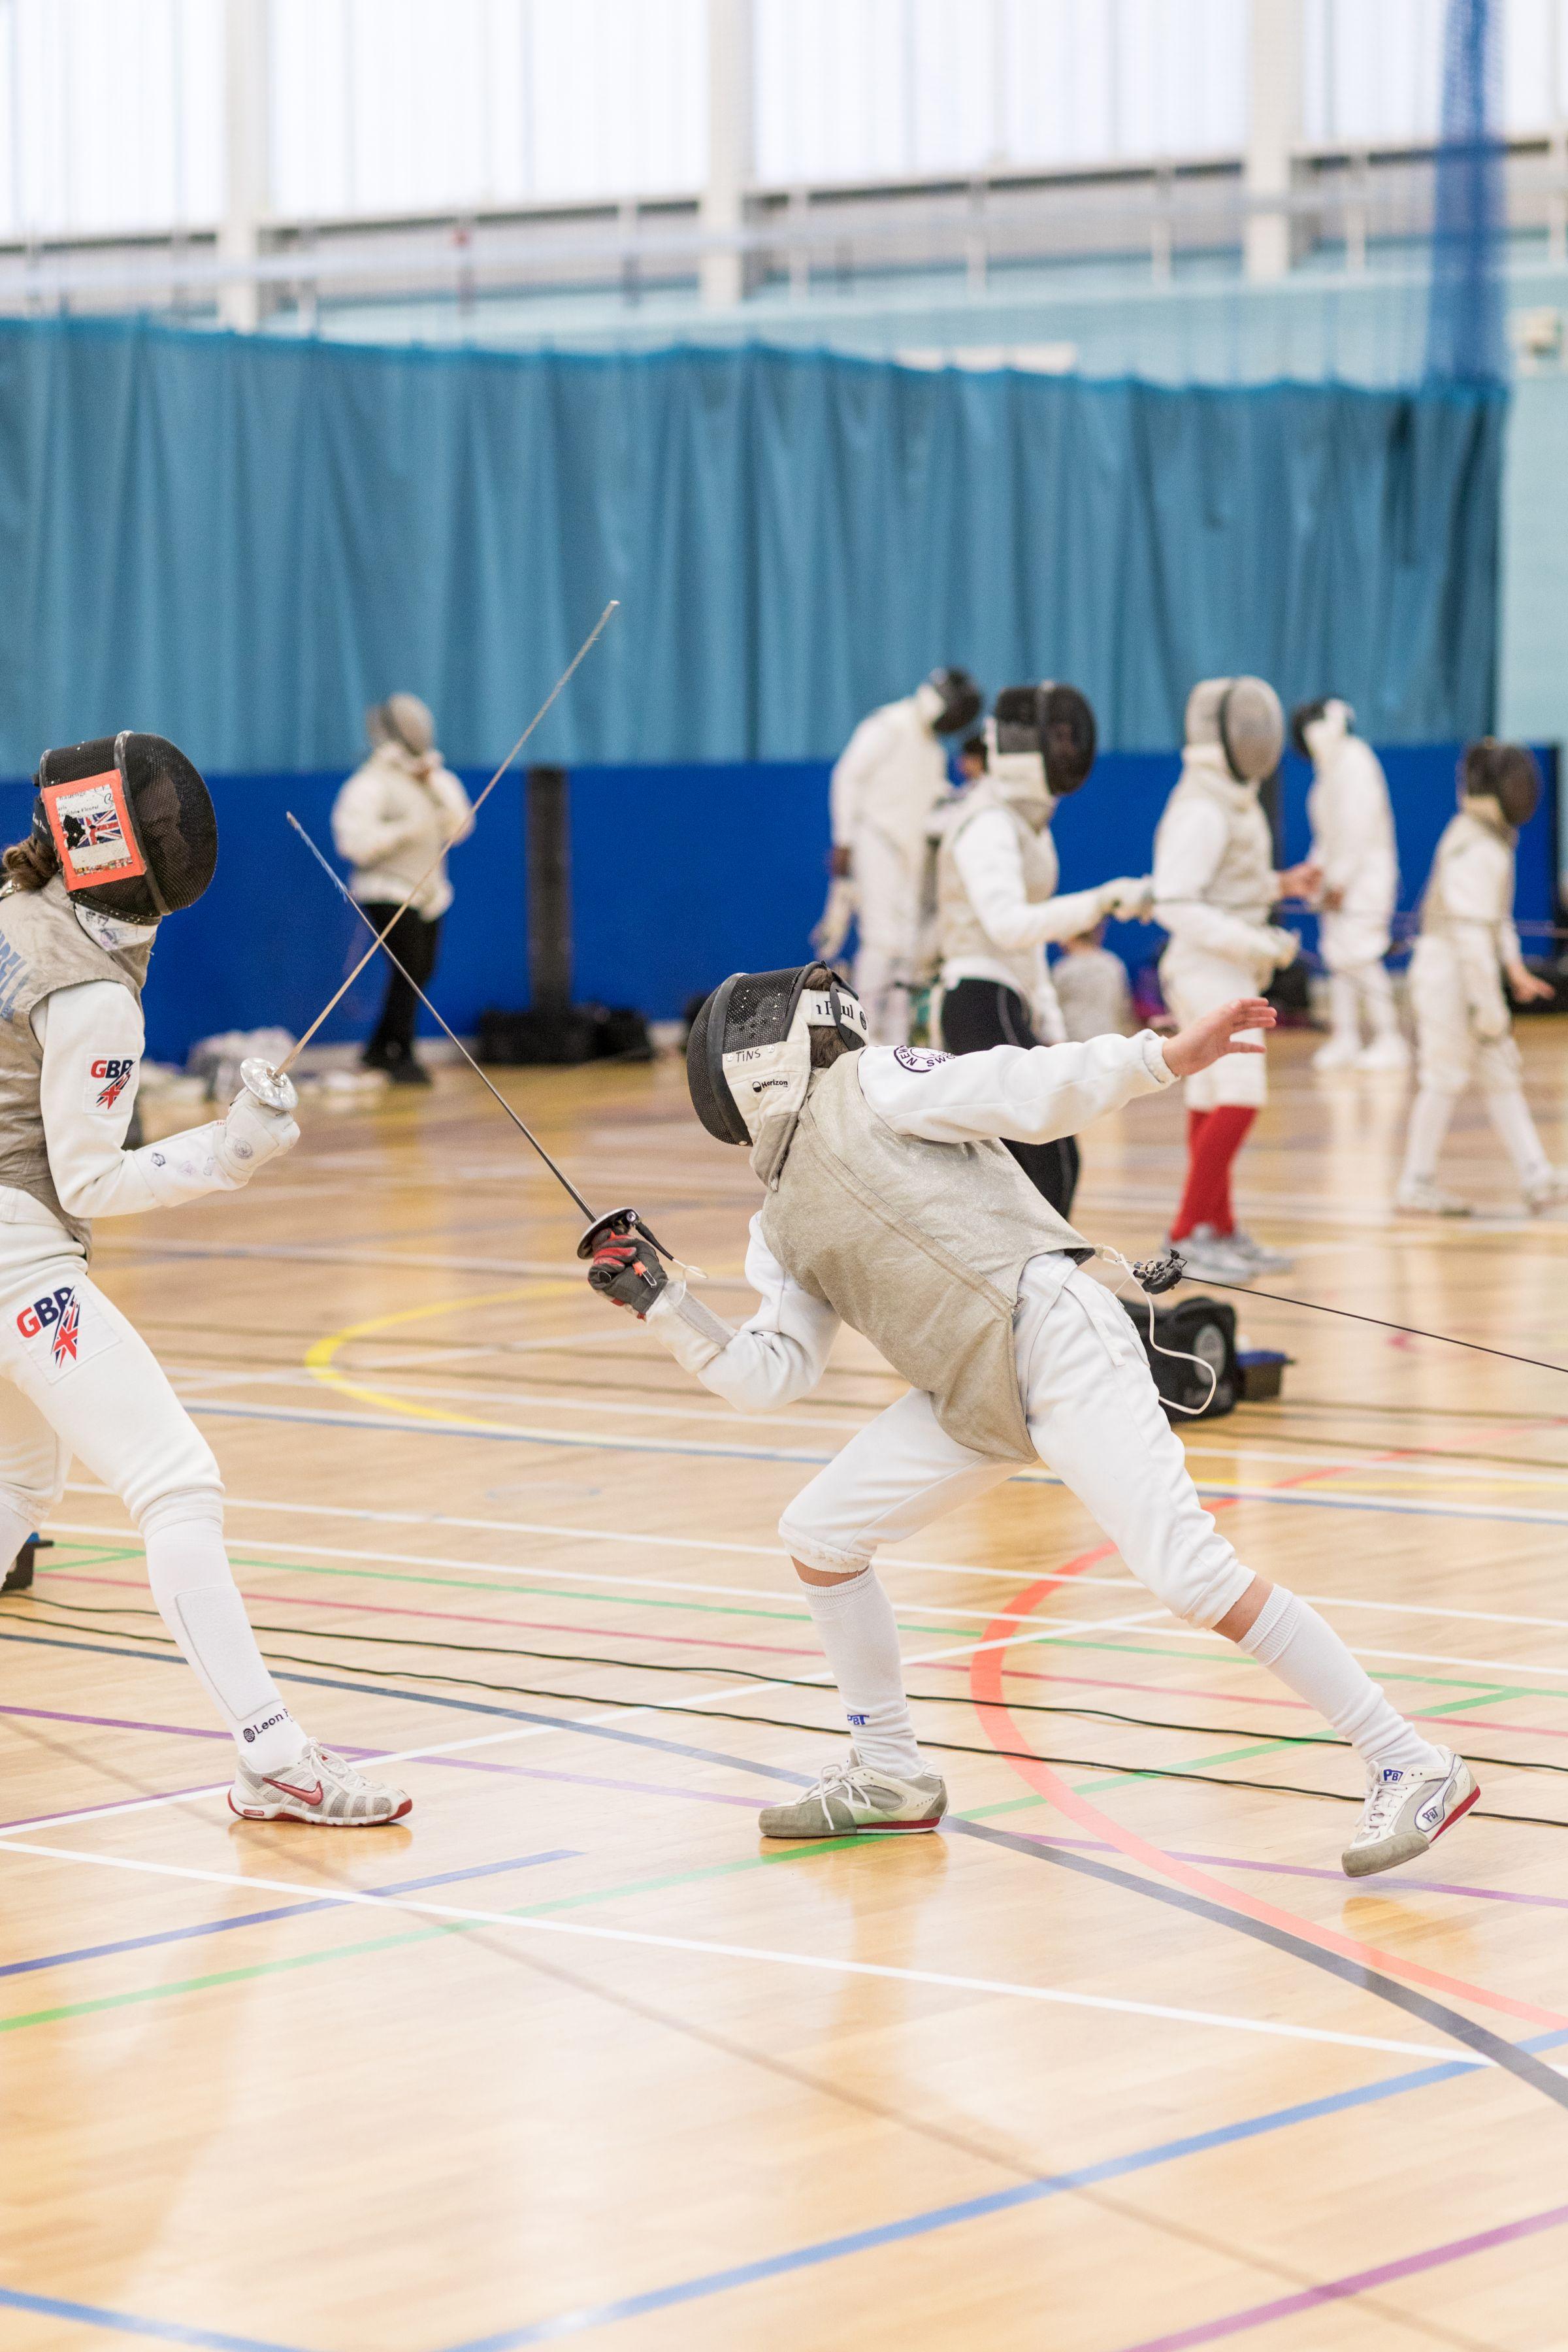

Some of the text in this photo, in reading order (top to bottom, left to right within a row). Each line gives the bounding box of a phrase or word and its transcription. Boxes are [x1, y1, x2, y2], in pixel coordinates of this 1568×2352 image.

[824, 1000, 855, 1021] Pul
[91, 1059, 135, 1079] GBR
[761, 1079, 788, 1088] Horizon
[16, 1286, 74, 1338] GBR
[253, 1713, 284, 1735] Leon
[1422, 1806, 1438, 1823] PBT
